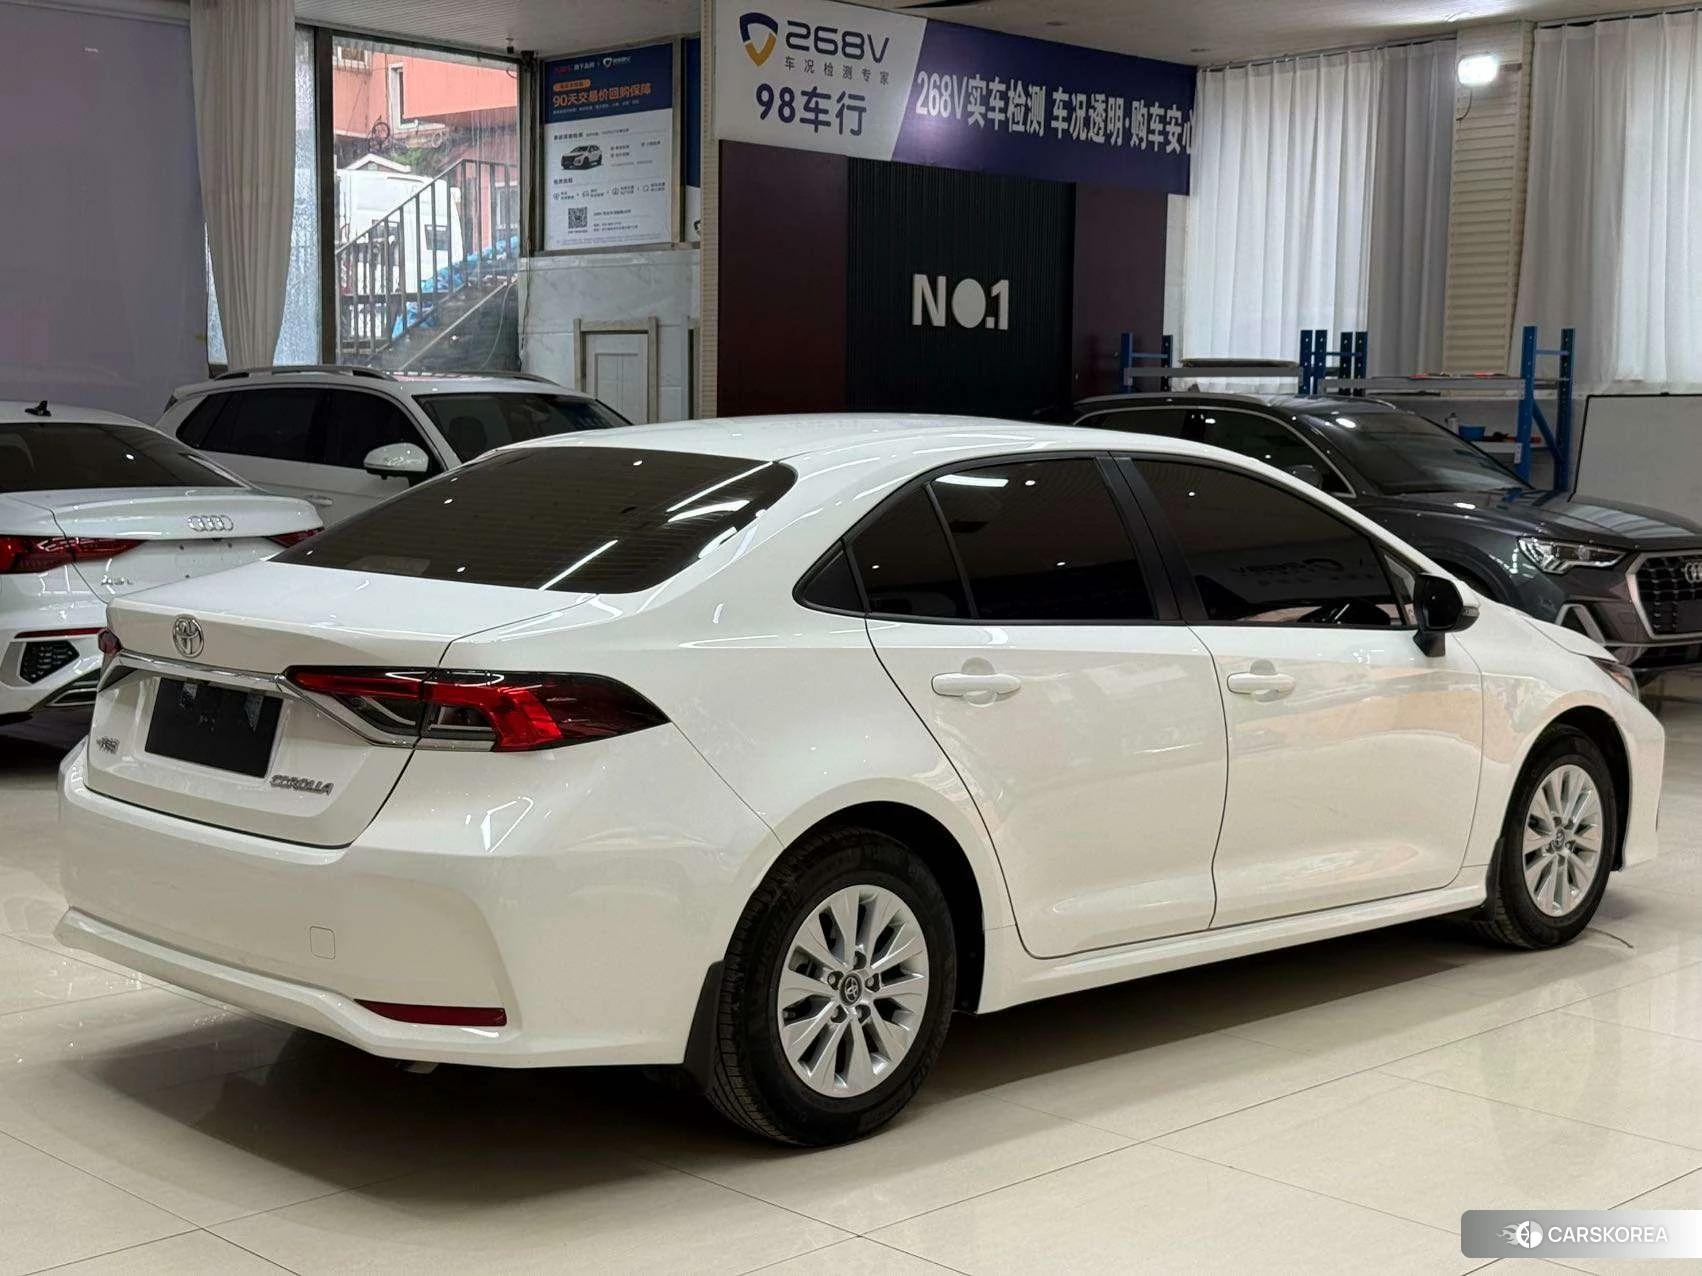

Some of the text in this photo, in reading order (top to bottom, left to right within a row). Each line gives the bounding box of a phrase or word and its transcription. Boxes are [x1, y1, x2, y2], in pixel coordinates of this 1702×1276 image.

[785, 19, 890, 64] 268V
[785, 55, 891, 85] 车况检测专家
[755, 83, 867, 136] 98车行
[915, 70, 1046, 137] 268V实车检测
